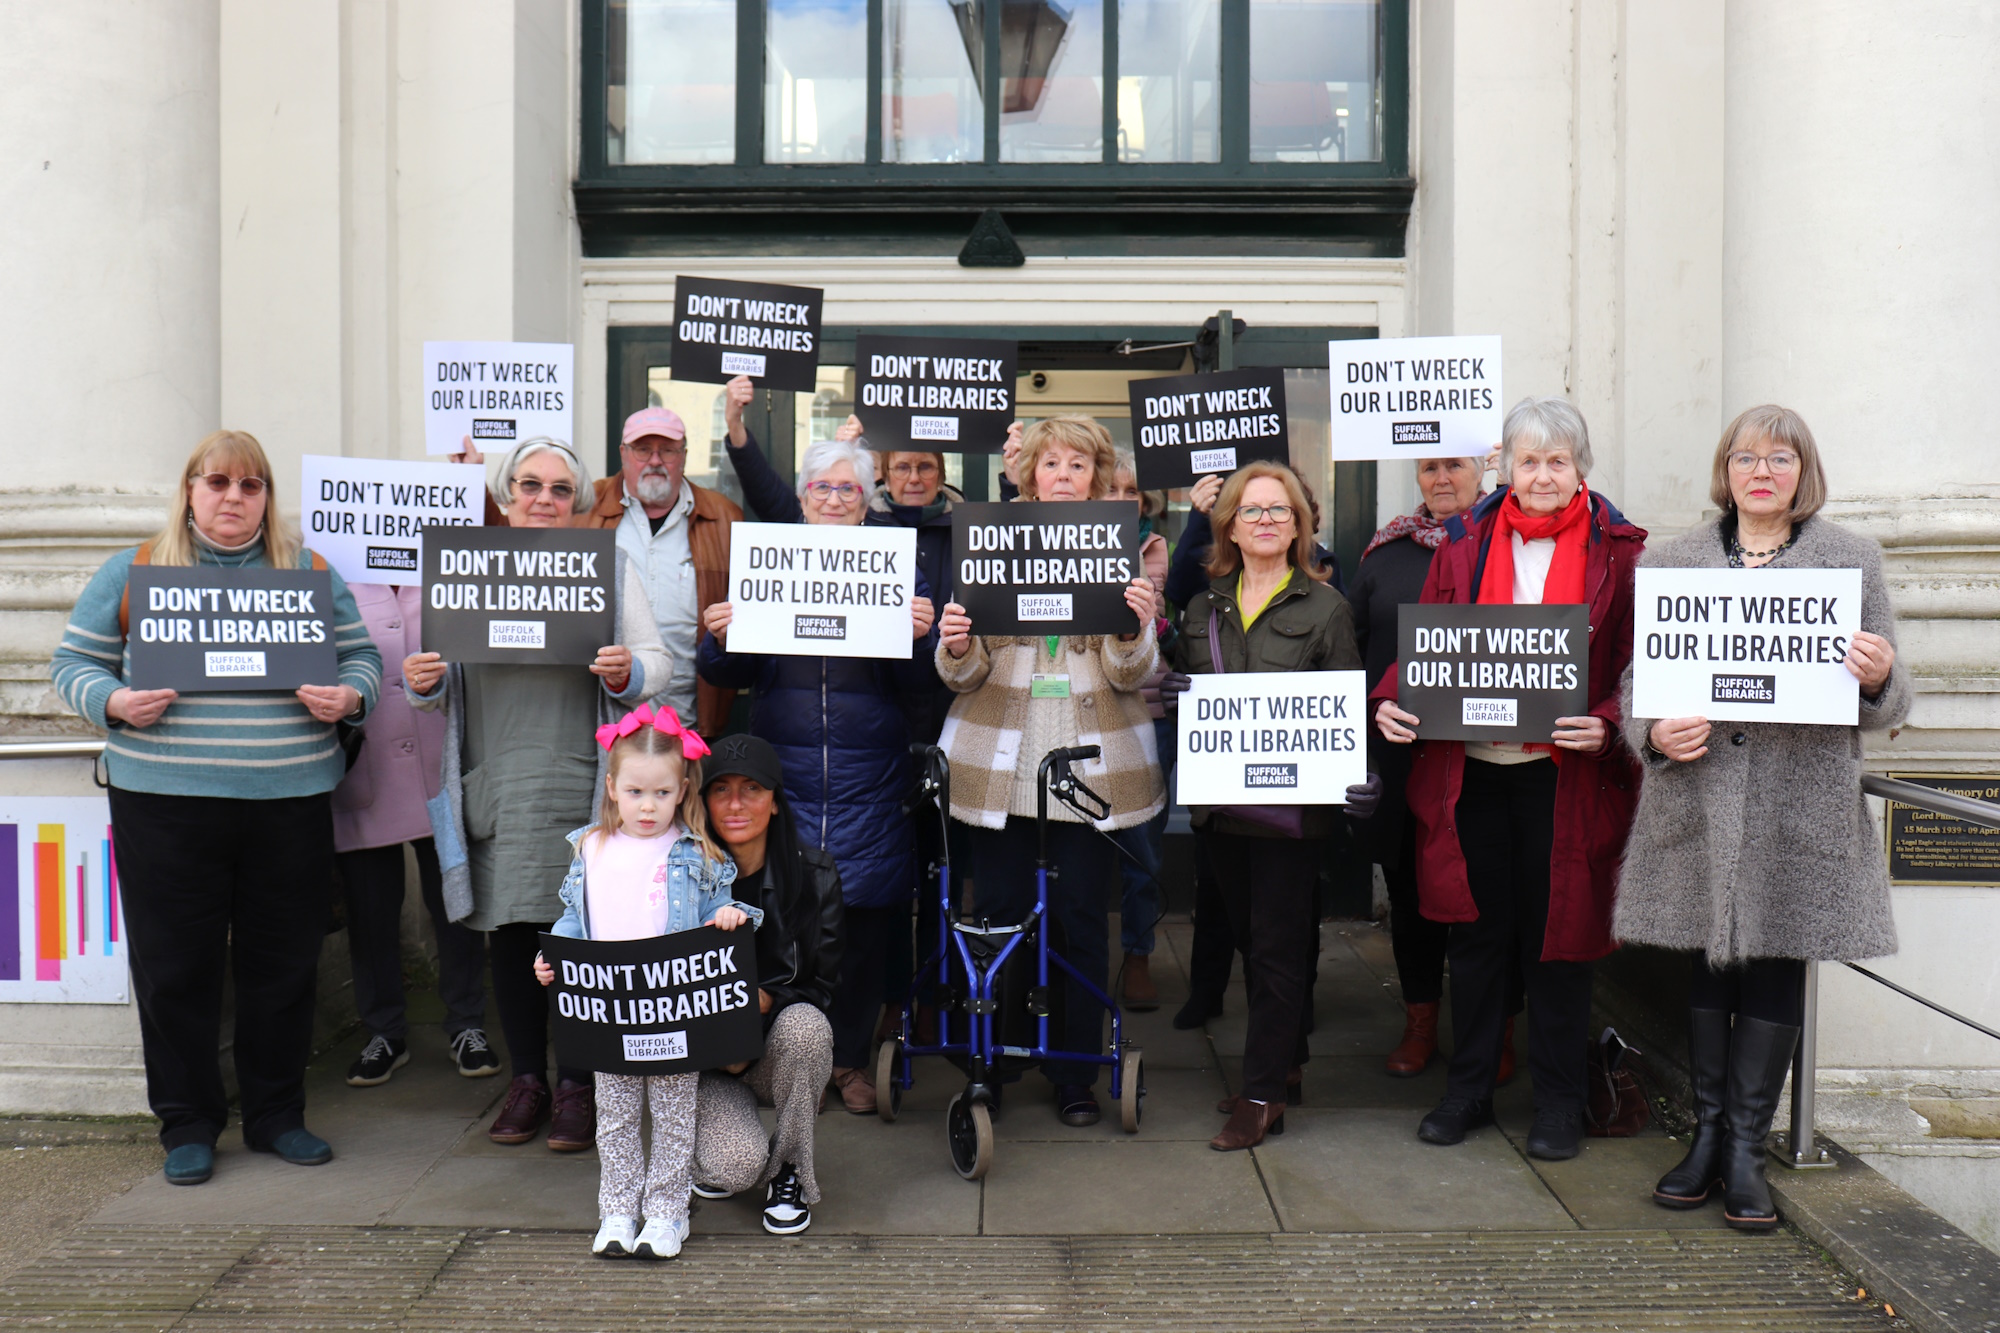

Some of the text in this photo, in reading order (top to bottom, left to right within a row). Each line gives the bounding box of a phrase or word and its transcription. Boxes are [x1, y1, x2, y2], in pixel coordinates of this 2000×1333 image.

[688, 295, 808, 325] DON'T WRECK
[680, 321, 812, 352] OUR LIBRARIES
[725, 356, 756, 365] SUFFOLK
[725, 364, 762, 373] LIBRARIES
[872, 355, 1002, 381] DON'T WRECK
[1348, 358, 1484, 383] DON'T WRECK
[438, 362, 556, 383] DON'T WRECK
[432, 390, 563, 410] OUR LIBRARIES
[863, 384, 1008, 410] OUR LIBRARIES
[1146, 387, 1272, 419] DON'T WRECK
[1341, 388, 1492, 413] OUR LIBRARIES
[475, 429, 514, 437] LIBRARIES
[1141, 414, 1280, 447] OUR LIBRARIES
[1395, 425, 1432, 433] SUFFOLK
[1395, 432, 1438, 441] LIBRARIES
[1194, 452, 1227, 462] SUFFOLK
[1195, 460, 1233, 469] LIBRARIES
[321, 480, 466, 508] DON'T WRECK
[312, 510, 354, 534] OUR
[969, 524, 1122, 550] DON'T WRECK
[369, 549, 409, 559] SUFFOLK
[369, 558, 415, 568] LIBRARIES
[441, 550, 597, 578] DON'T WRECK
[750, 547, 896, 574] DON'T WRECK
[962, 558, 1130, 584] OUR LIBRARIES
[150, 587, 314, 613] DON'T WRECK
[432, 584, 604, 612] OUR LIBRARIES
[740, 579, 903, 606] OUR LIBRARIES
[1022, 599, 1062, 607] SUFFOLK
[1658, 596, 1837, 624] DON'T WRECK
[141, 618, 325, 642] OUR LIBRARIES
[493, 625, 534, 634] SUFFOLK
[797, 627, 844, 636] LIBRARIES
[798, 618, 837, 627] SUFFOLK
[493, 635, 542, 643] LIBRARIES
[1416, 628, 1569, 654] DON'T WRECK
[1647, 633, 1846, 664] OUR LIBRARIES
[1407, 662, 1577, 690] OUR LIBRARIES
[1716, 678, 1764, 689] SUFFOLK
[1716, 688, 1772, 699] LIBRARIES
[1198, 696, 1346, 720] DON'T WRECK
[1467, 703, 1506, 711] SUFFOLK
[1467, 713, 1513, 721] LIBRARIES
[1189, 728, 1355, 752] OUR LIBRARIES
[1248, 767, 1288, 776] SUFFOLK
[1248, 776, 1295, 784] LIBRARIES
[1986, 788, 1998, 798] Of
[1912, 812, 1934, 821] (Lord
[562, 946, 737, 990] DON'T WRECK
[558, 980, 748, 1024] OUR LIBRARIES
[628, 1038, 674, 1047] SUFFOLK
[629, 1046, 684, 1056] LIBRARIES
